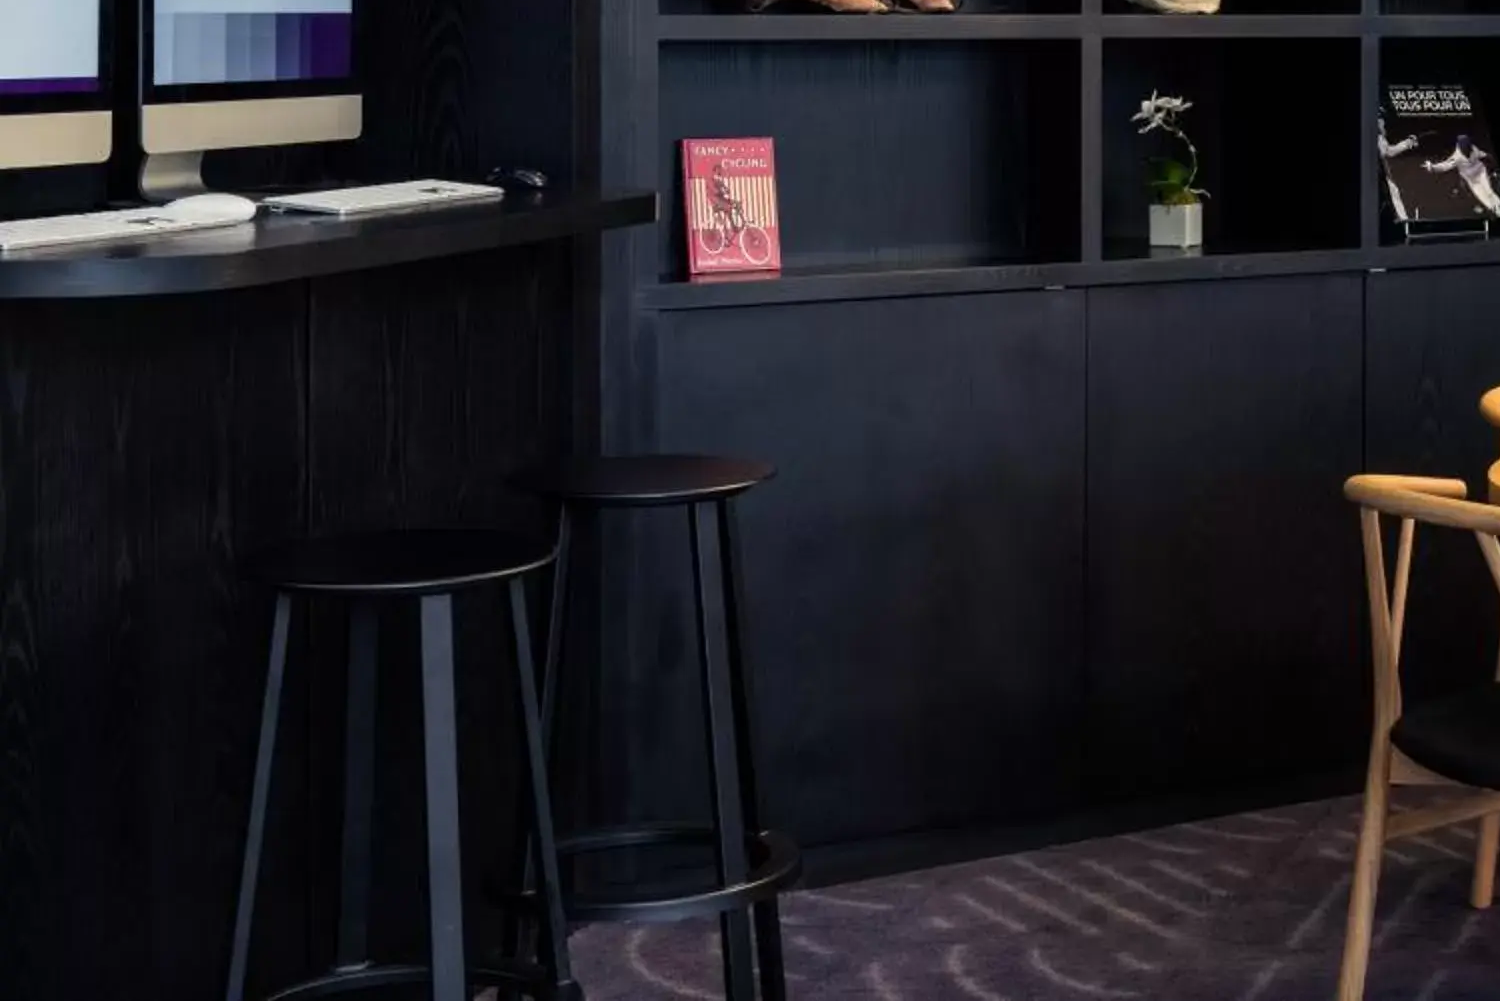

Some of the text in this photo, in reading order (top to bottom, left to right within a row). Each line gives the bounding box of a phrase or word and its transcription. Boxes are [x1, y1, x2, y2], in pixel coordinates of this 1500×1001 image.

[1407, 90, 1437, 100] POUR
[1392, 100, 1471, 111] TOUS POUR UN
